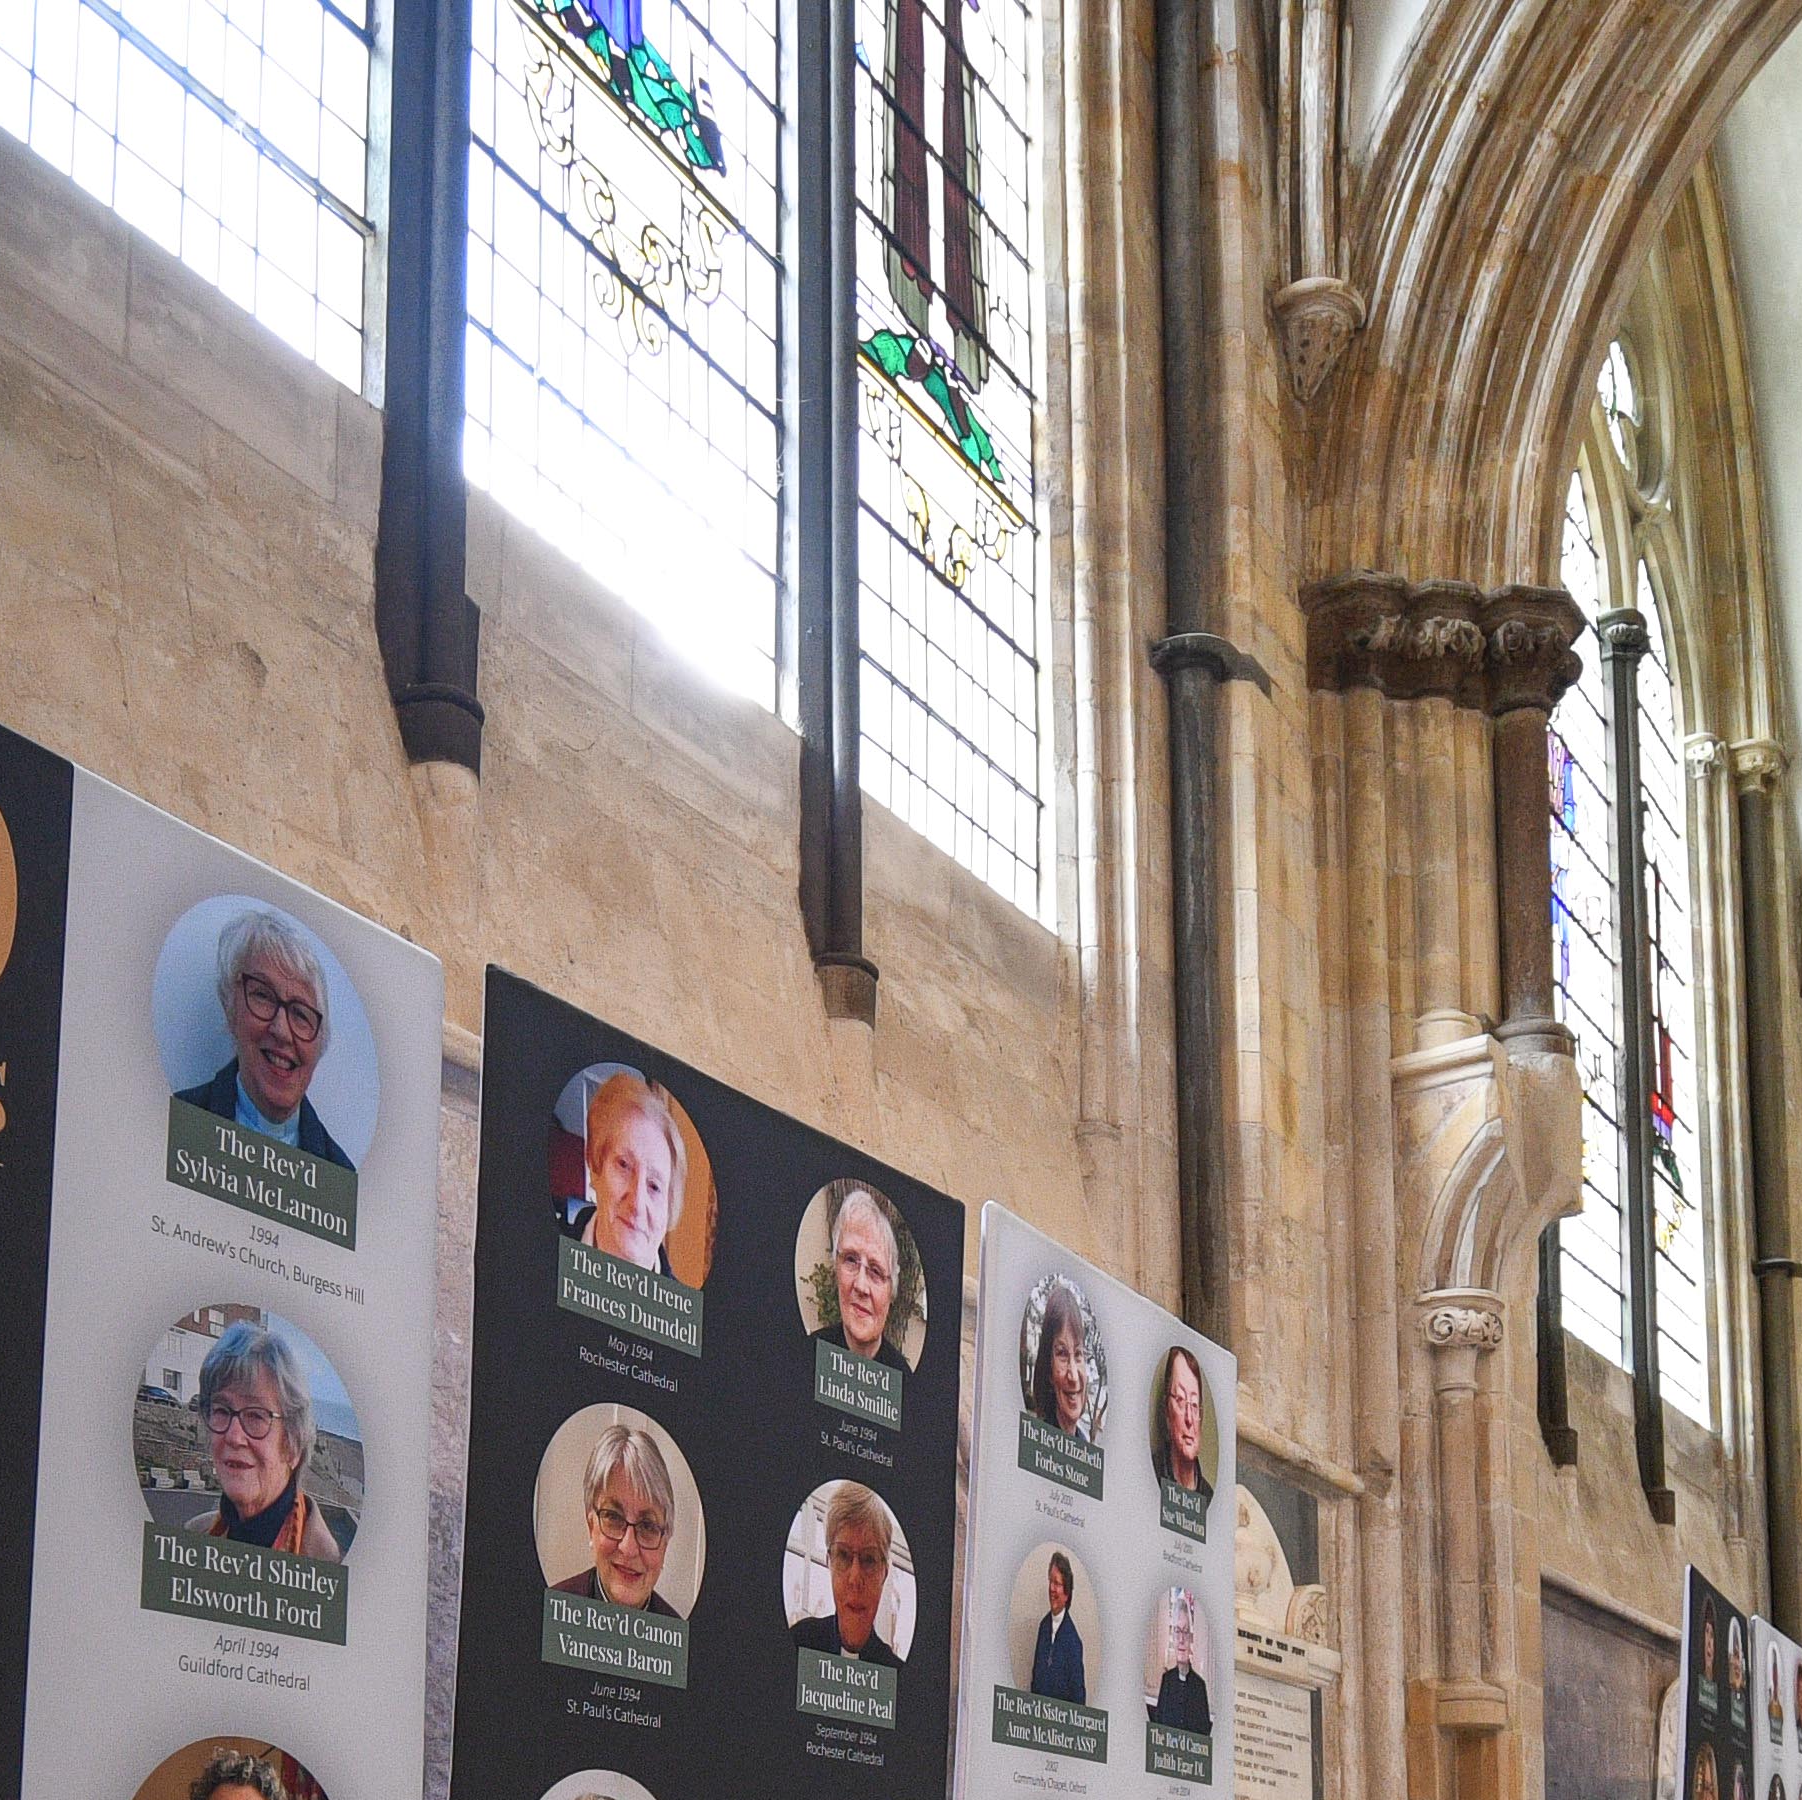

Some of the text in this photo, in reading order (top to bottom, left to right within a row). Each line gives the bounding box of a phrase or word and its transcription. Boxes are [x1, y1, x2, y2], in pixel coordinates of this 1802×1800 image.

[216, 1126, 317, 1189] The Rev'd
[176, 1150, 347, 1236] Sylvia McLarnon
[249, 1225, 280, 1248] 1994
[151, 1216, 365, 1305] St. Andrew's Church, Burgess Hill
[571, 1248, 693, 1314] The Rev'd Irene
[563, 1277, 697, 1346] Frances Durndell
[579, 1346, 678, 1393] Rochester Cathedral
[608, 1335, 654, 1362] May 1994
[831, 1351, 889, 1392] The Rev'd
[819, 1375, 898, 1422] Linda Smillie
[1022, 1419, 1102, 1470] The Rev'd Elizabeth
[1035, 1450, 1064, 1478] Forbes
[155, 1534, 339, 1600] The Rev'd Shirley
[171, 1577, 321, 1630] Elsworth Ford
[550, 1599, 683, 1647] The Rev'd Canon
[214, 1634, 279, 1659] April 1994
[559, 1633, 672, 1676] Vanessa Baron
[179, 1655, 310, 1691] Guildford Cathedral
